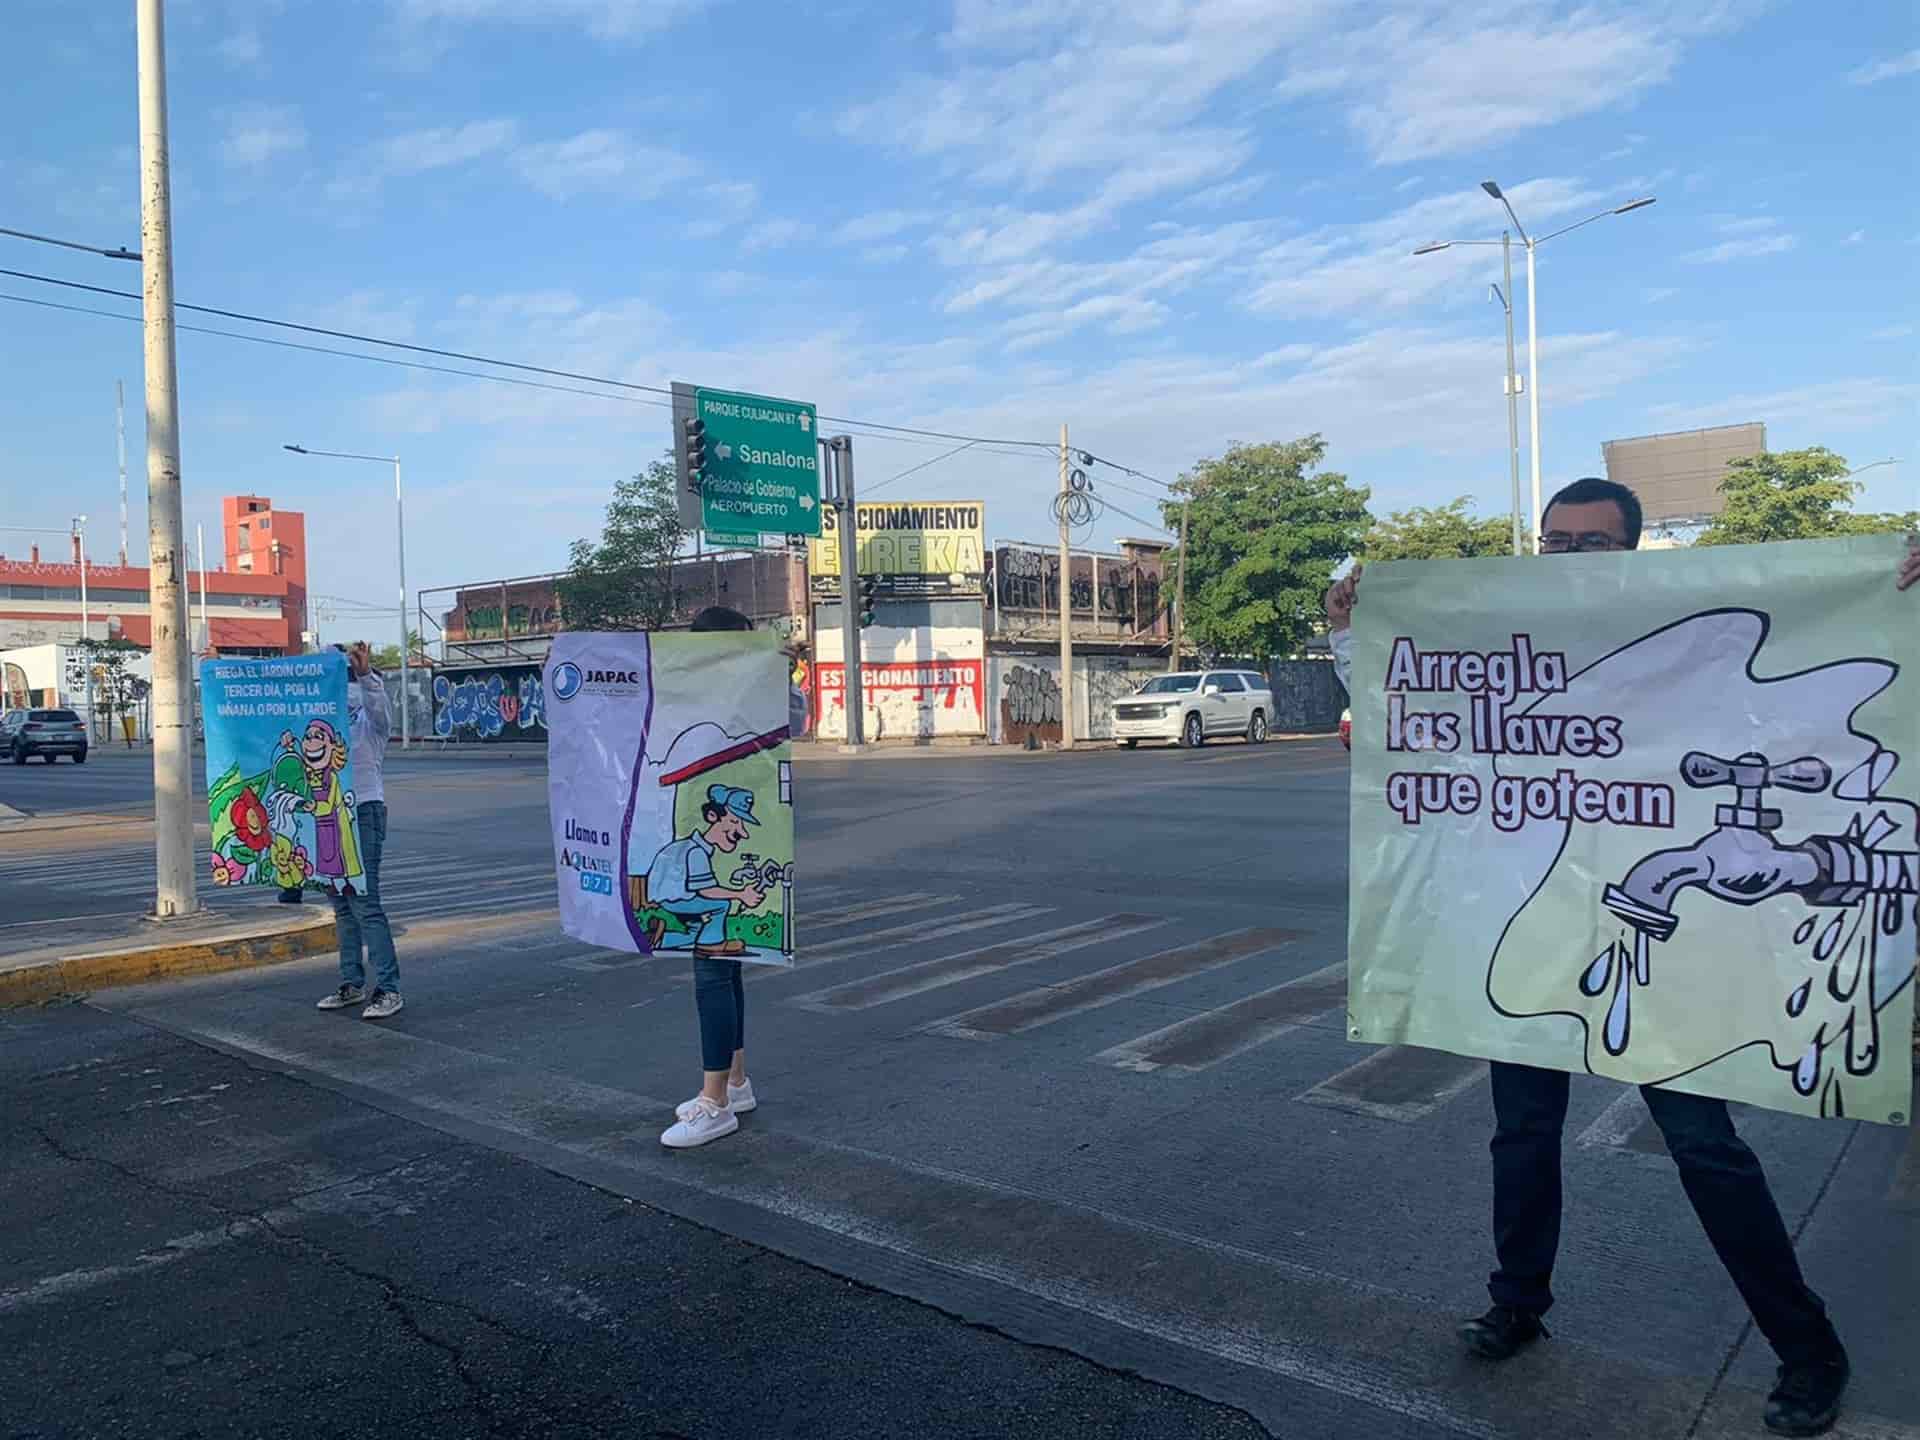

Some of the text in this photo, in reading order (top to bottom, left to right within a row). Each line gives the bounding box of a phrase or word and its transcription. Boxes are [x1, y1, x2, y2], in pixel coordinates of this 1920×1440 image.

[704, 400, 741, 418] PARQUE
[740, 443, 816, 470] Sanalona
[708, 474, 796, 499] Palacio de Gobierno
[710, 499, 788, 516] AEROPUERTO
[824, 507, 978, 530] SCIONAMIENTO
[295, 663, 325, 677] CADA
[585, 670, 639, 684] JAPAC
[821, 667, 975, 687] ESTCIONAMIENTO
[1385, 633, 1568, 705] Arregla
[224, 684, 262, 697] TERCER
[284, 683, 306, 696] POR
[307, 682, 320, 696] LA
[257, 703, 264, 715] O
[266, 703, 287, 715] POR
[288, 702, 300, 714] LA
[302, 701, 337, 714] TARDE
[1387, 694, 1624, 759] las llaves
[1387, 768, 1675, 832] que gotean
[566, 818, 610, 846] Llama a
[560, 847, 613, 874] AQUATEL
